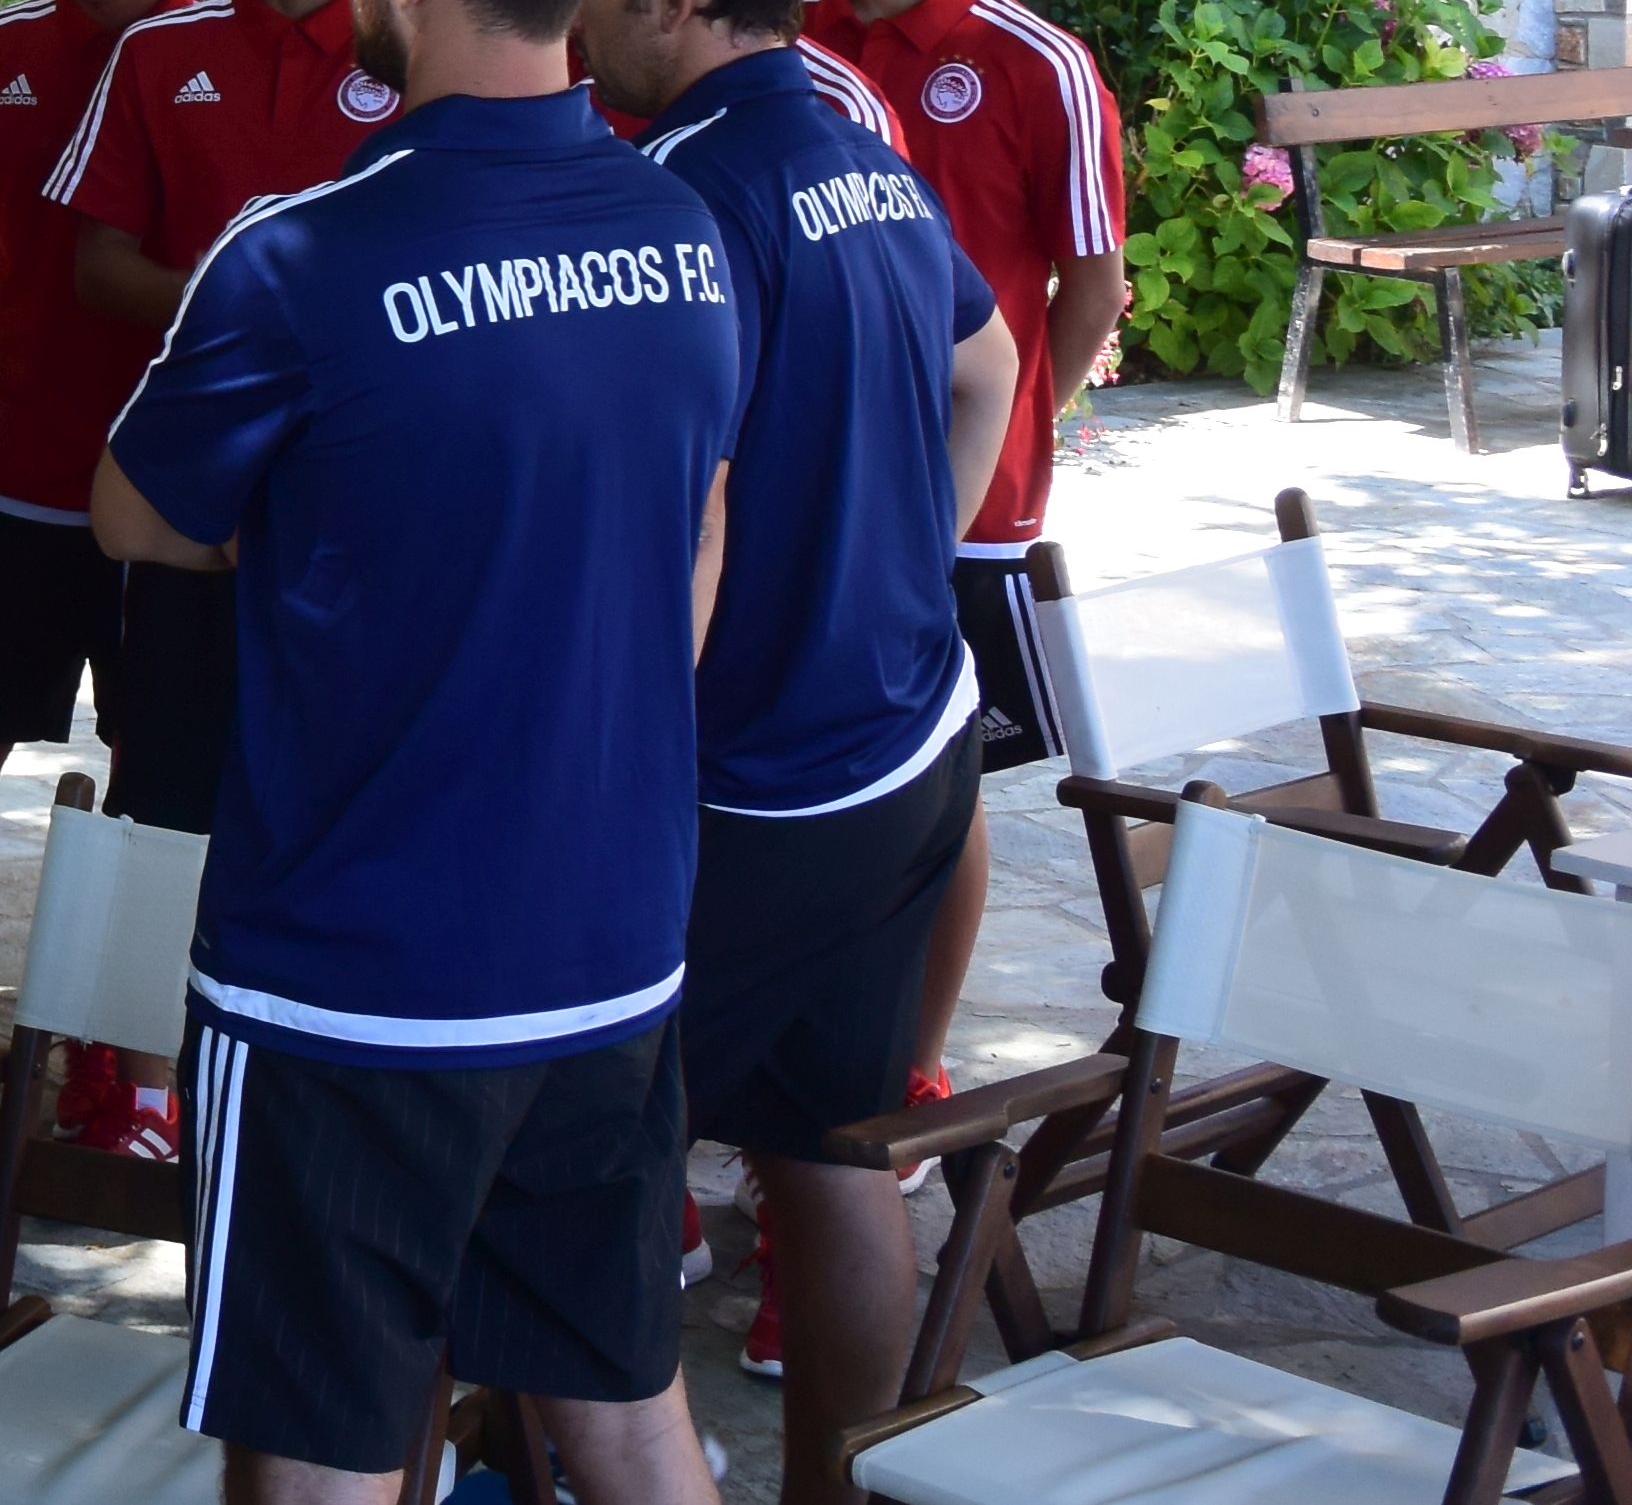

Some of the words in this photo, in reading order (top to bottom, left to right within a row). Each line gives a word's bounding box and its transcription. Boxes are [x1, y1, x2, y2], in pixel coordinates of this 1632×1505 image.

[174, 91, 222, 104] adidas
[383, 245, 669, 343] OLYMPIACOS
[674, 243, 726, 304] F.C.
[982, 725, 1023, 742] didas
